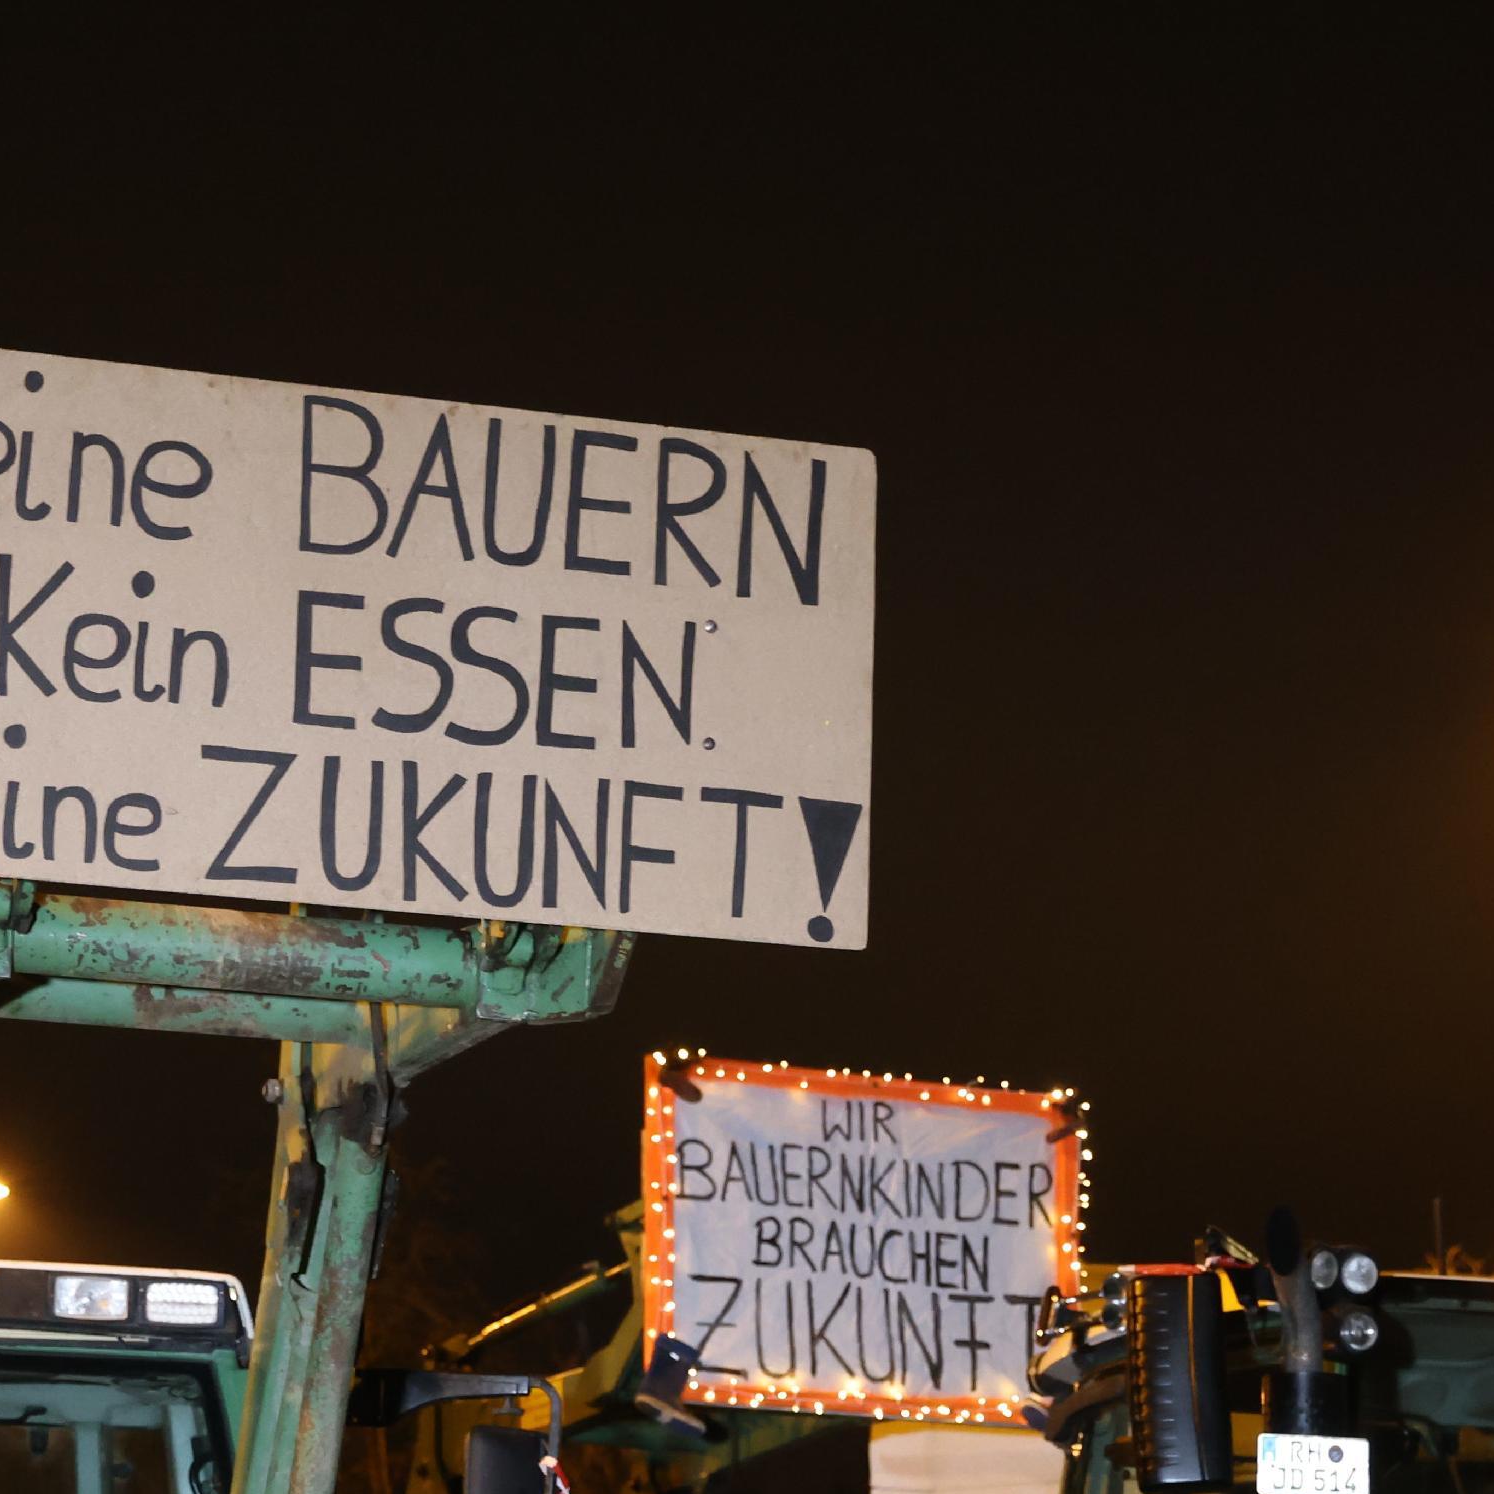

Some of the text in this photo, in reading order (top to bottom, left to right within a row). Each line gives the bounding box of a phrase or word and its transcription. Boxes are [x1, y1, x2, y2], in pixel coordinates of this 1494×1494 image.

[299, 395, 826, 605] BAUERN
[202, 745, 862, 942] ZUKUNFT!
[821, 1100, 897, 1143] WIR
[675, 1139, 1053, 1228] BAUERNKINDER
[753, 1216, 990, 1293] BRAUCHEN
[689, 1273, 1045, 1391] ZUKUNFT
[1273, 1467, 1356, 1492] JD 514
[1291, 1441, 1321, 1463] RH
